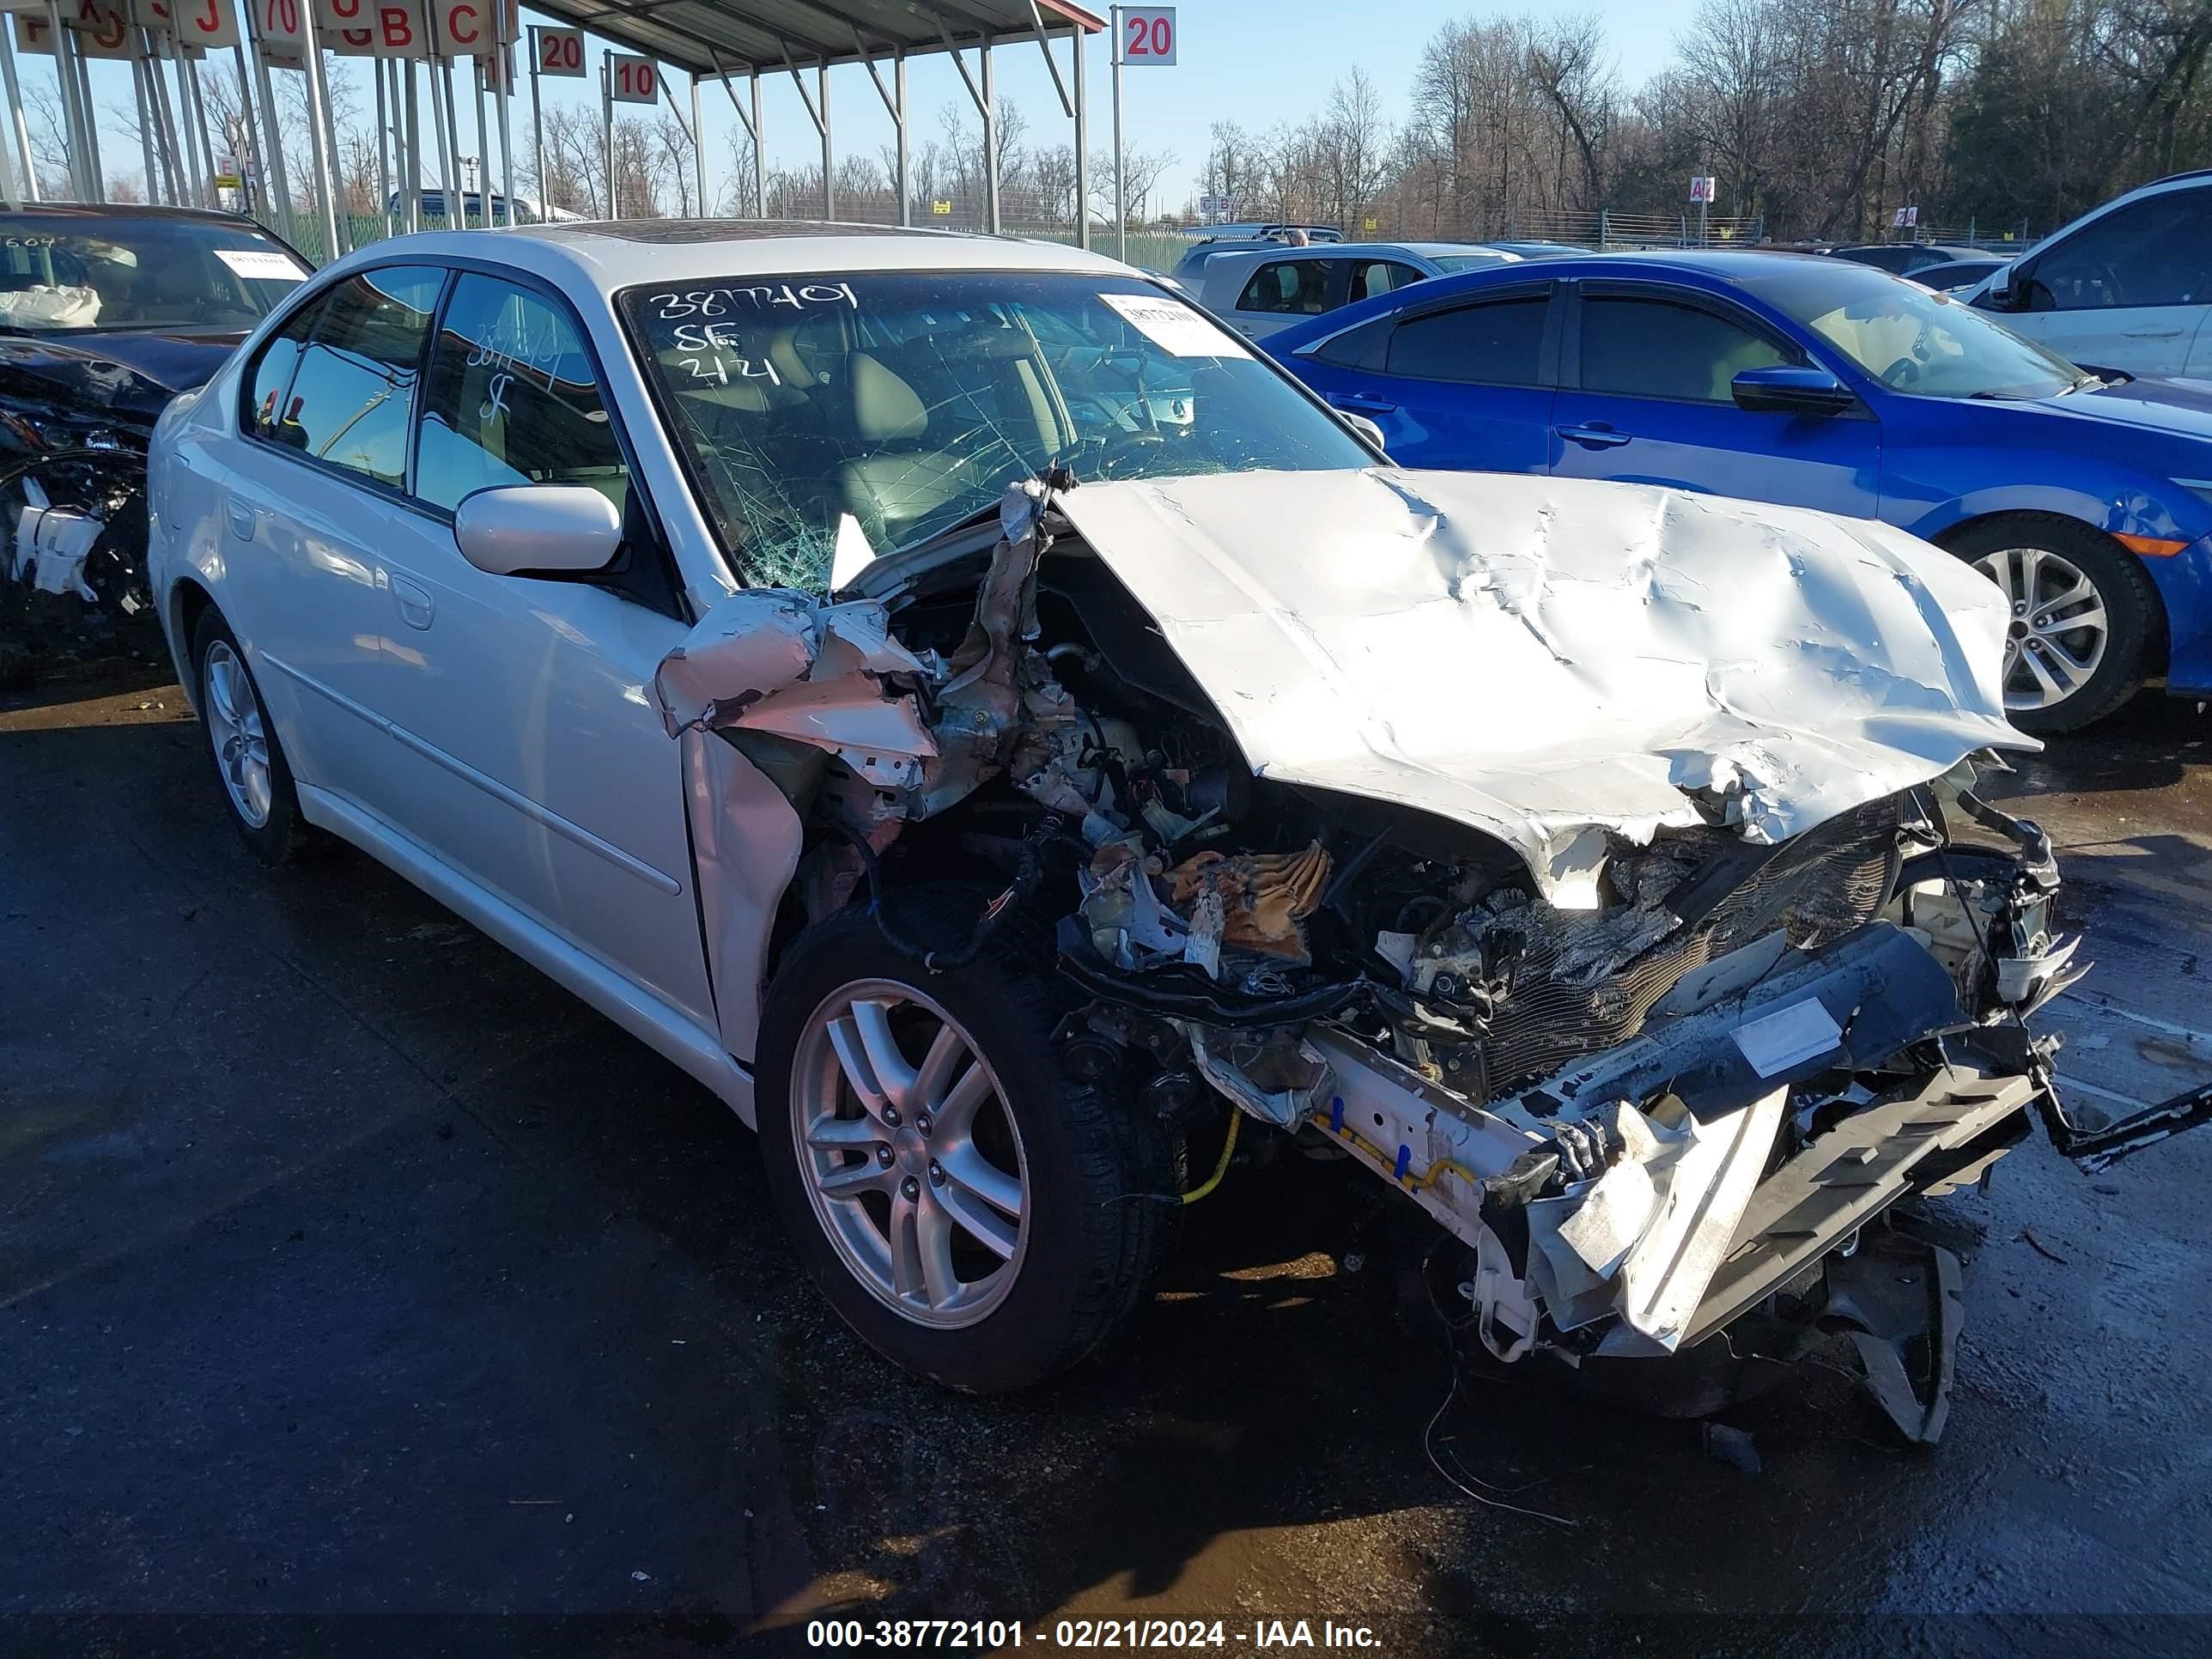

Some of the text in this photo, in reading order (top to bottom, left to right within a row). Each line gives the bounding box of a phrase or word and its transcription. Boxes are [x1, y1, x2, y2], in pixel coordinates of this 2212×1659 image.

[380, 9, 412, 46] B
[449, 4, 479, 44] C
[1127, 17, 1171, 56] 20
[543, 35, 581, 69] 20
[619, 63, 653, 95] 10
